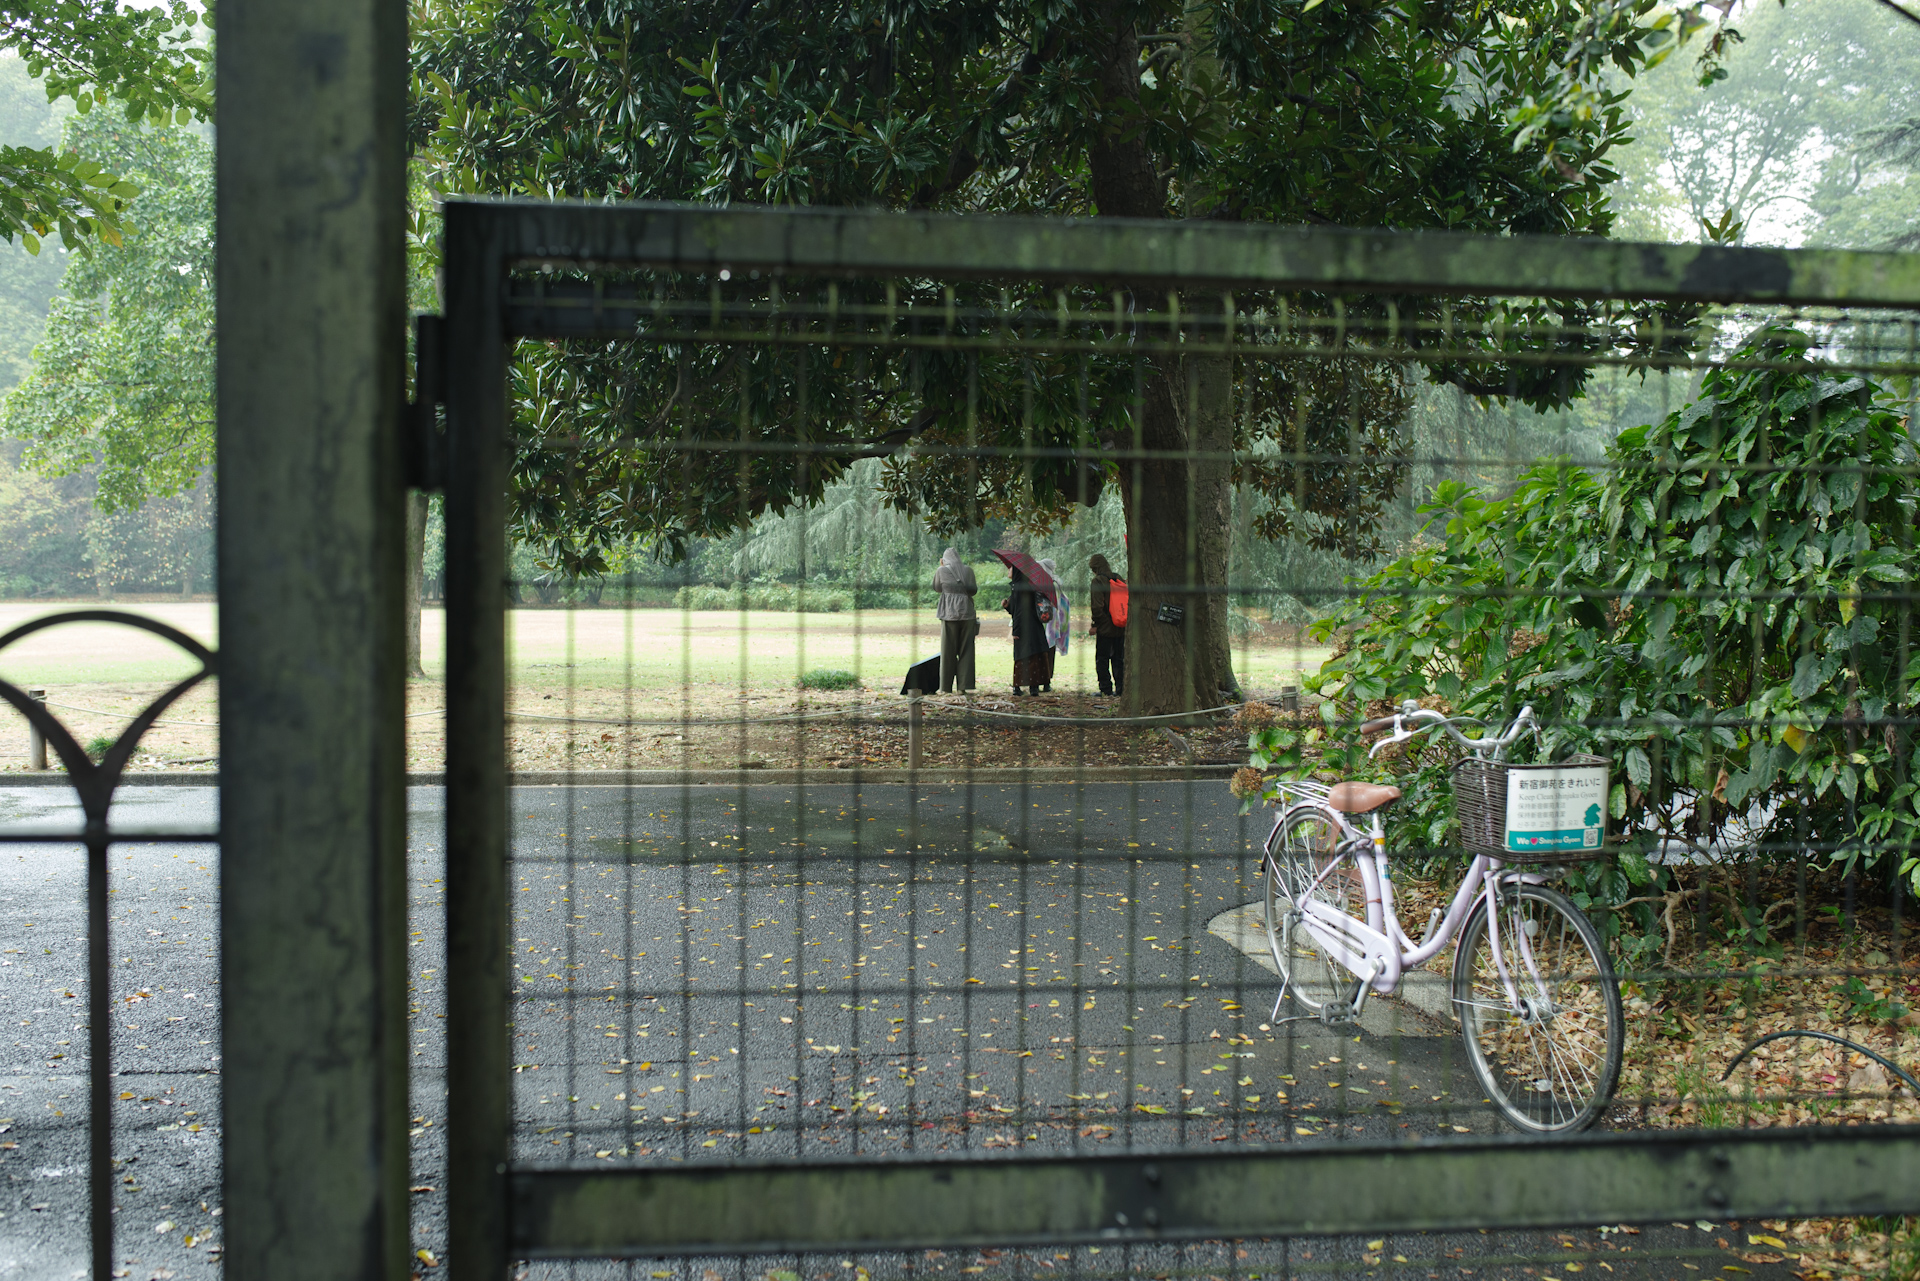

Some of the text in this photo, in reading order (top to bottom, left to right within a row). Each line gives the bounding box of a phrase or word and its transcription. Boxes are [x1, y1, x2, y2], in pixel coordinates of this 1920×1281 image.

[1519, 778, 1600, 790] 新宿御苑をきれいに
